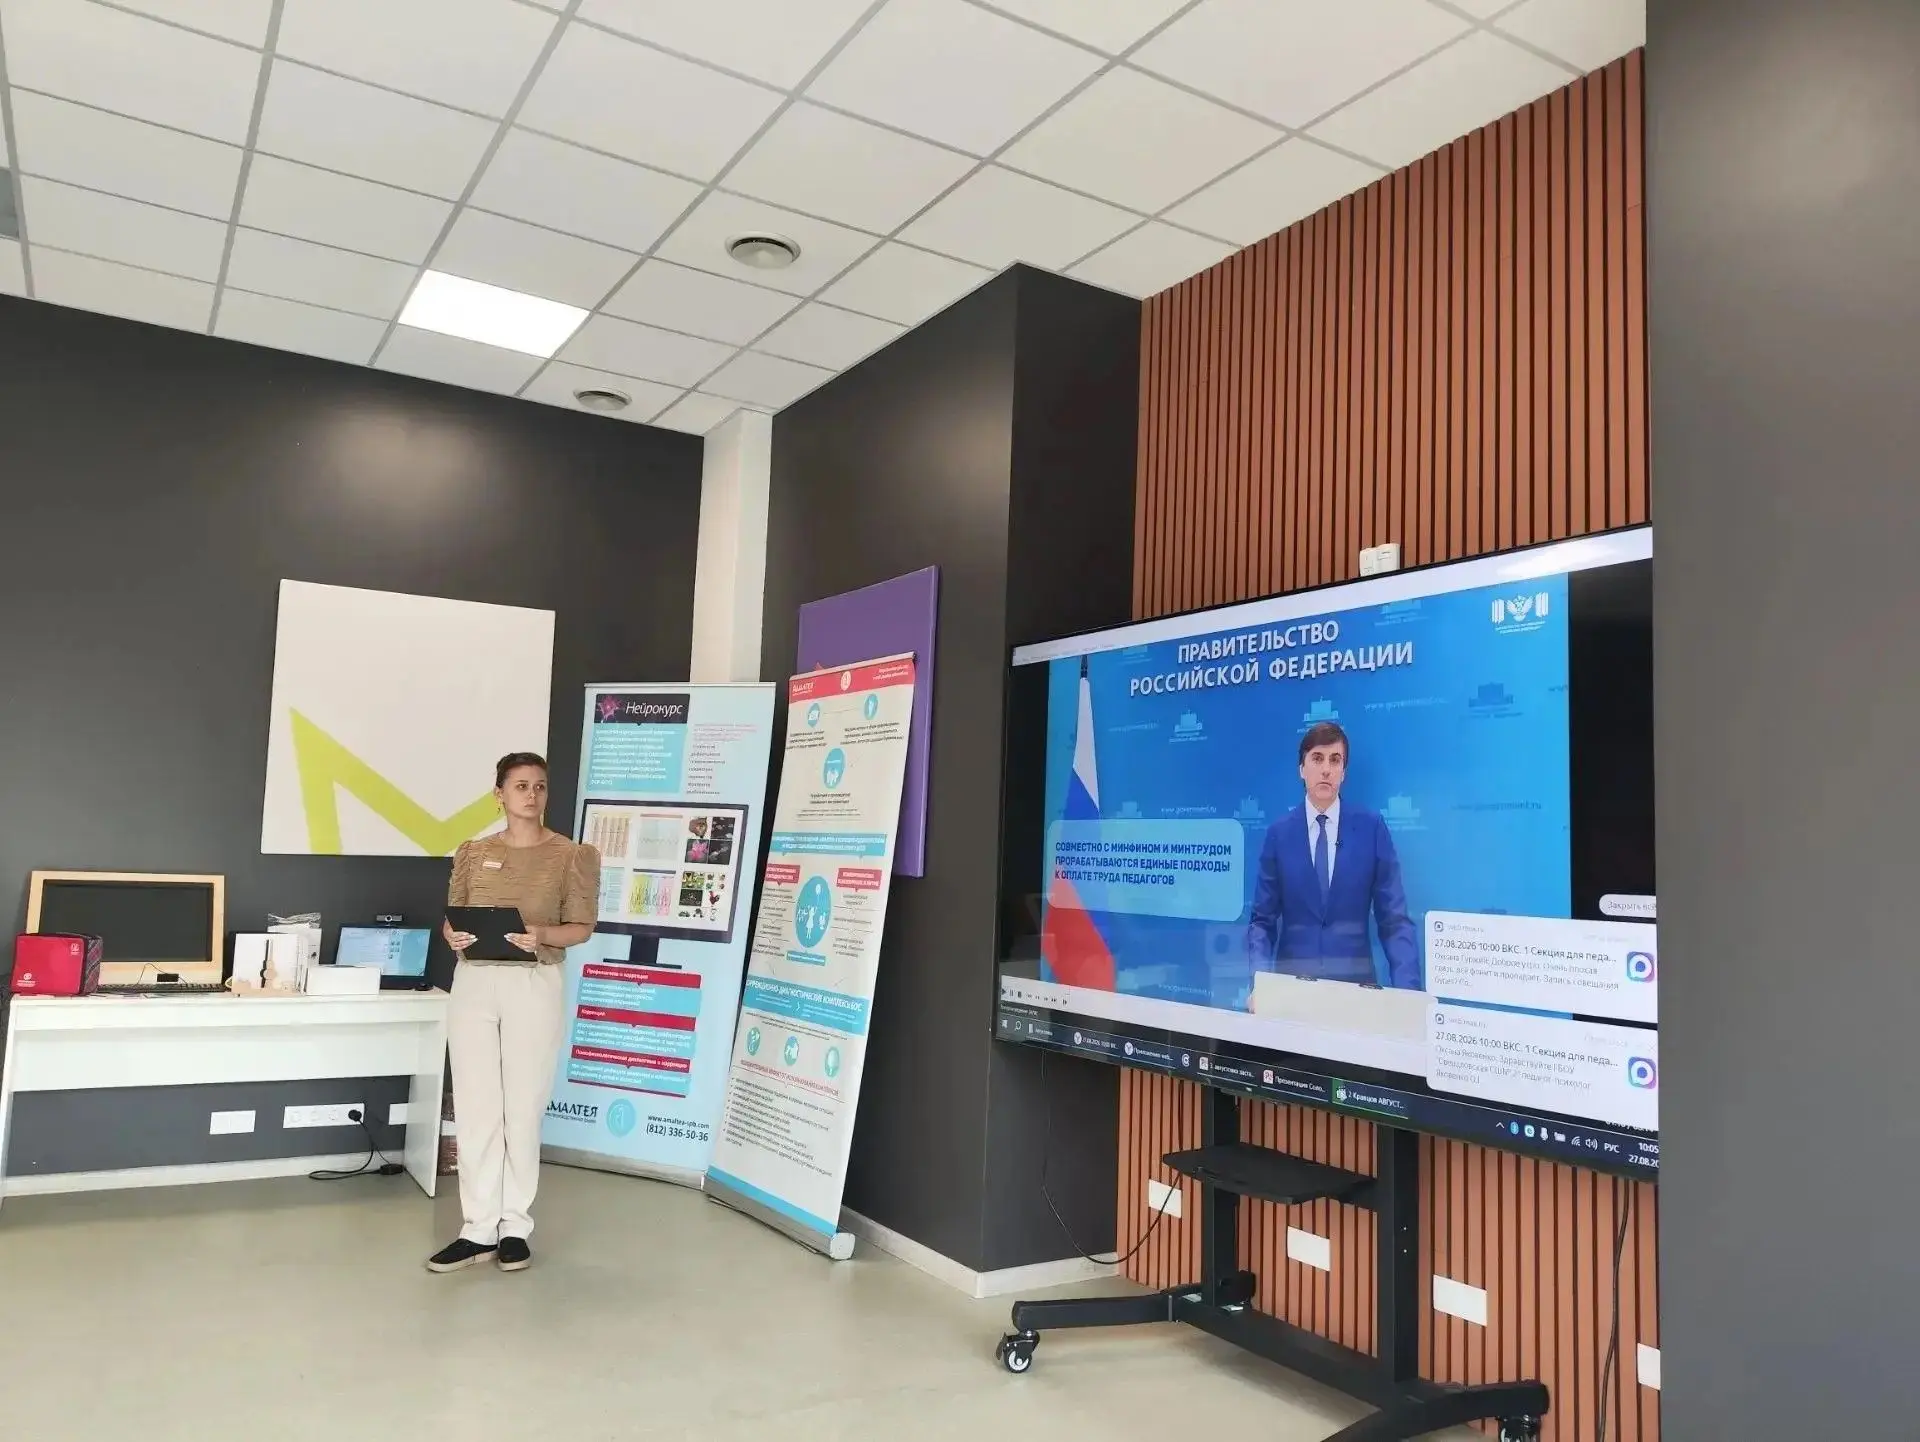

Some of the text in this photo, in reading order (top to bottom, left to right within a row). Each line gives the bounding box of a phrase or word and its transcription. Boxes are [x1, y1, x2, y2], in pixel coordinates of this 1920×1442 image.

[1178, 620, 1339, 664] ПРАВИТЕЛЬСТВО
[1130, 641, 1413, 697] РОССИЙСКОЙ ФЕДЕРАЦИИ
[625, 701, 683, 718] Нейрокурс
[1055, 842, 1232, 856] СОВМЕСТНО С МИНФИНОМ И МИНТРУДОМ
[1055, 856, 1230, 872] ПРОРАБАТЫВАЮТСЯ ЕДИНЫЕ ПОДХОДЫ
[1055, 870, 1175, 885] К ОПЛАТЕ ТРУДА ПЕДАГОГОВ
[1434, 939, 1476, 951] 27.08.2026
[1478, 943, 1500, 953] 10:00
[1531, 946, 1564, 958] Секция
[1566, 951, 1584, 960] для
[1435, 1031, 1477, 1045] 27.08.2026
[1479, 1038, 1501, 1048] 10:00
[1532, 1045, 1566, 1058] Секция
[1567, 1052, 1585, 1061] для
[546, 1100, 599, 1118] МАЛТЕЯ
[646, 1123, 709, 1142] (812) 336-50-36
[1603, 1142, 1620, 1153] РУС
[1638, 1142, 1659, 1154] 10:05
